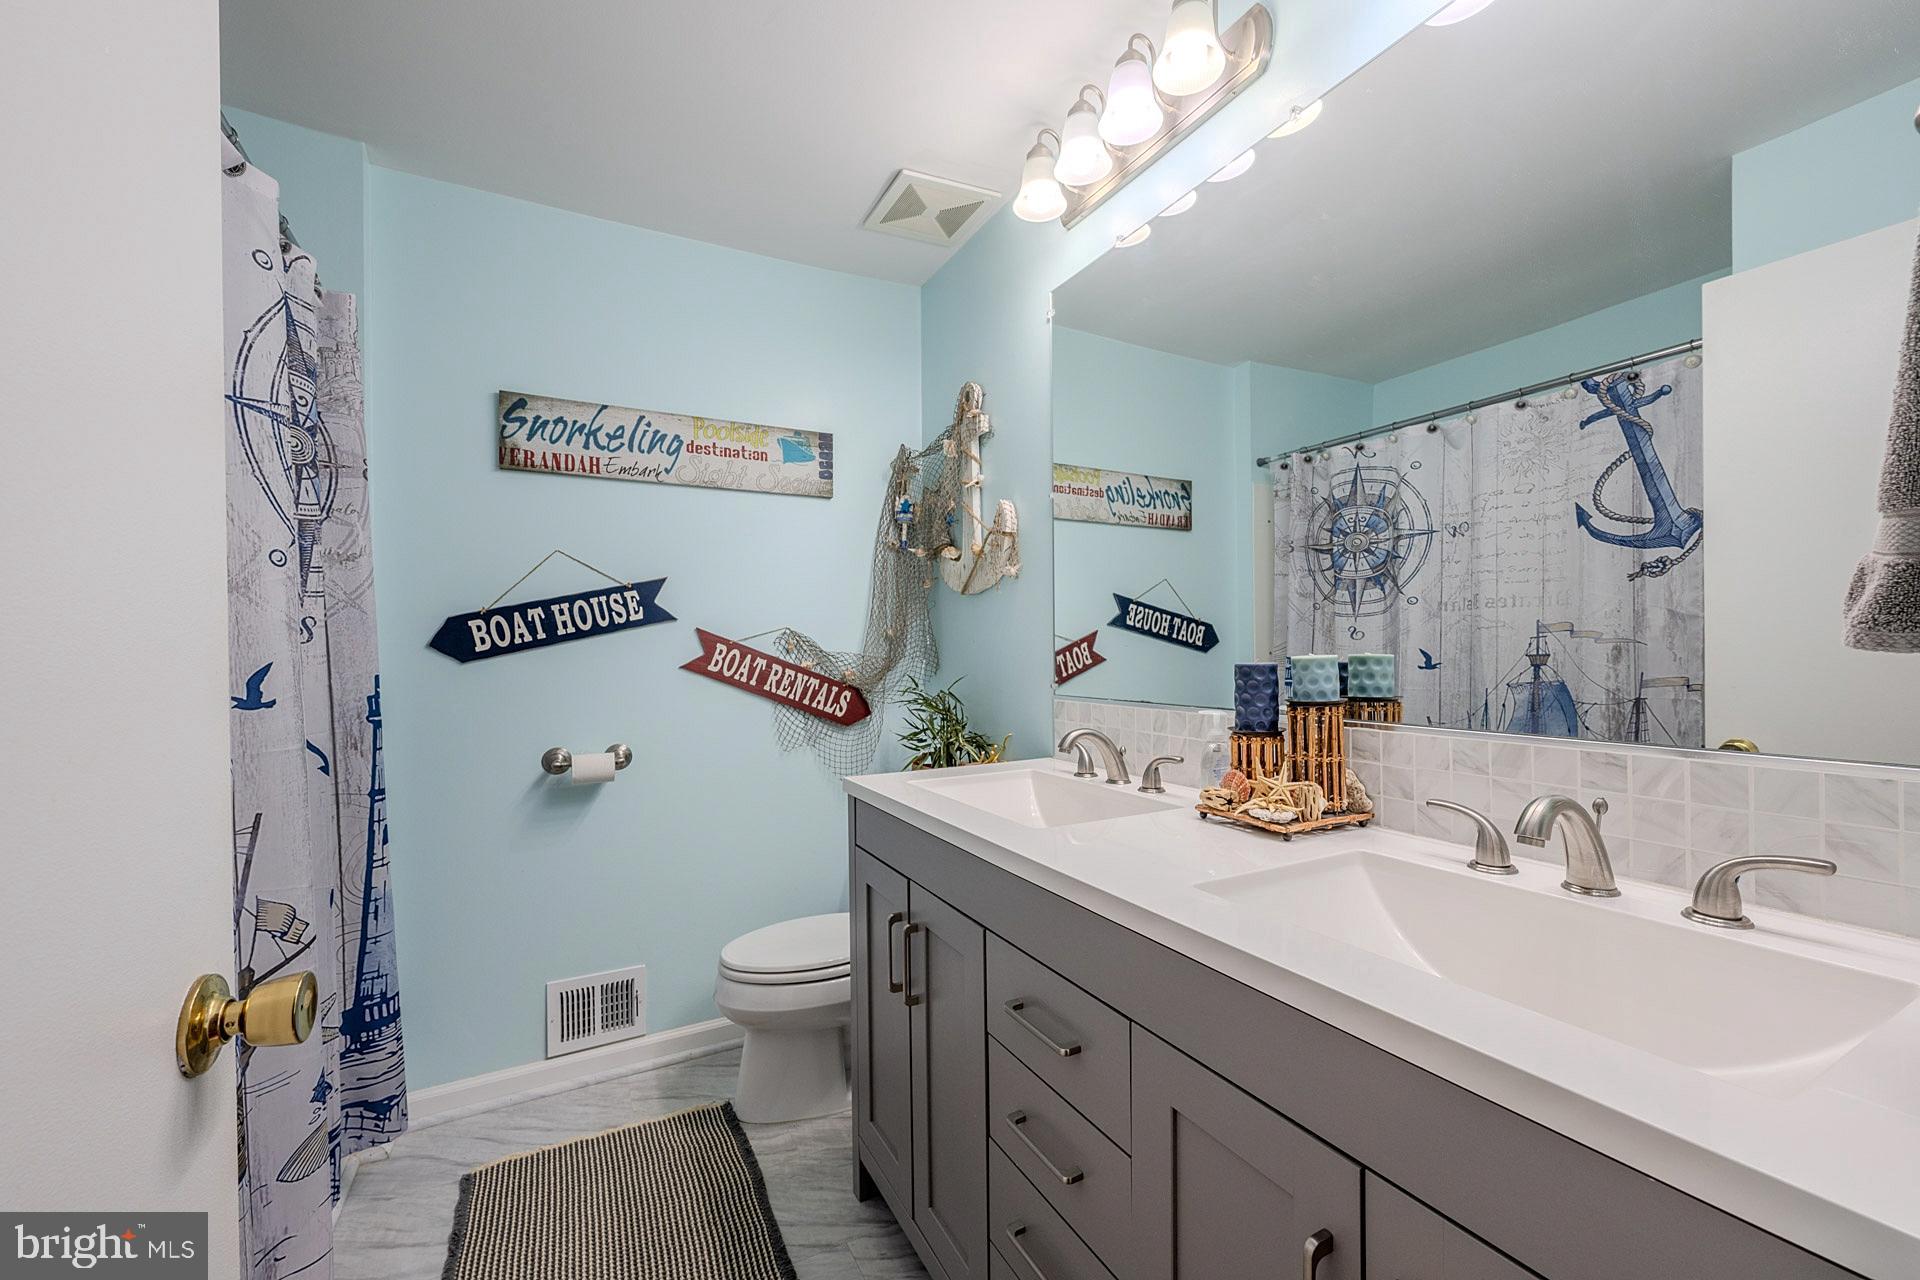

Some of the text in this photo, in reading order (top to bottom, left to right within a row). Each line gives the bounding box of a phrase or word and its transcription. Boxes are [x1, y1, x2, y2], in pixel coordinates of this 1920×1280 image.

[501, 398, 684, 475] Snorkeling
[686, 440, 769, 463] destination
[693, 416, 770, 449] Poolside
[603, 456, 666, 483] Embark
[468, 590, 644, 653] BOAT HOUSE
[708, 642, 852, 718] BOAT RENTALS
